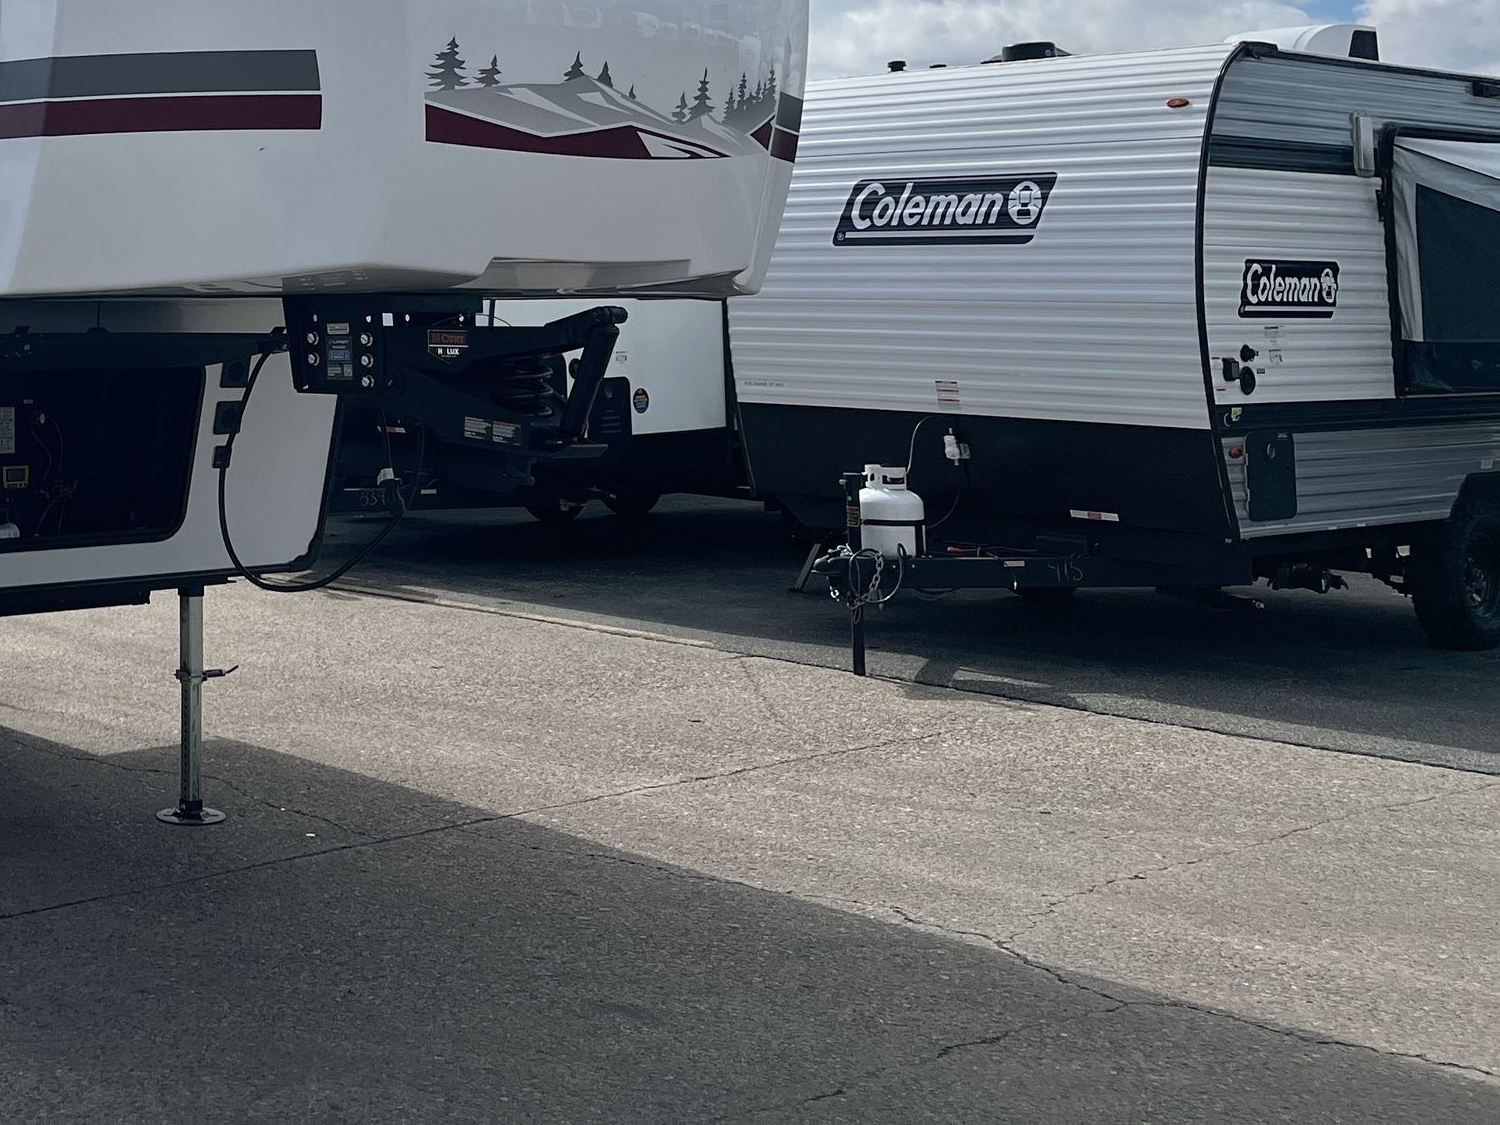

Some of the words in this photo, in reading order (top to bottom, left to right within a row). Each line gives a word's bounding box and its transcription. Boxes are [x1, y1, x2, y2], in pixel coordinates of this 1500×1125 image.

[851, 182, 1004, 230] Coleman
[1246, 263, 1321, 304] Coleman
[437, 347, 460, 355] HLUX
